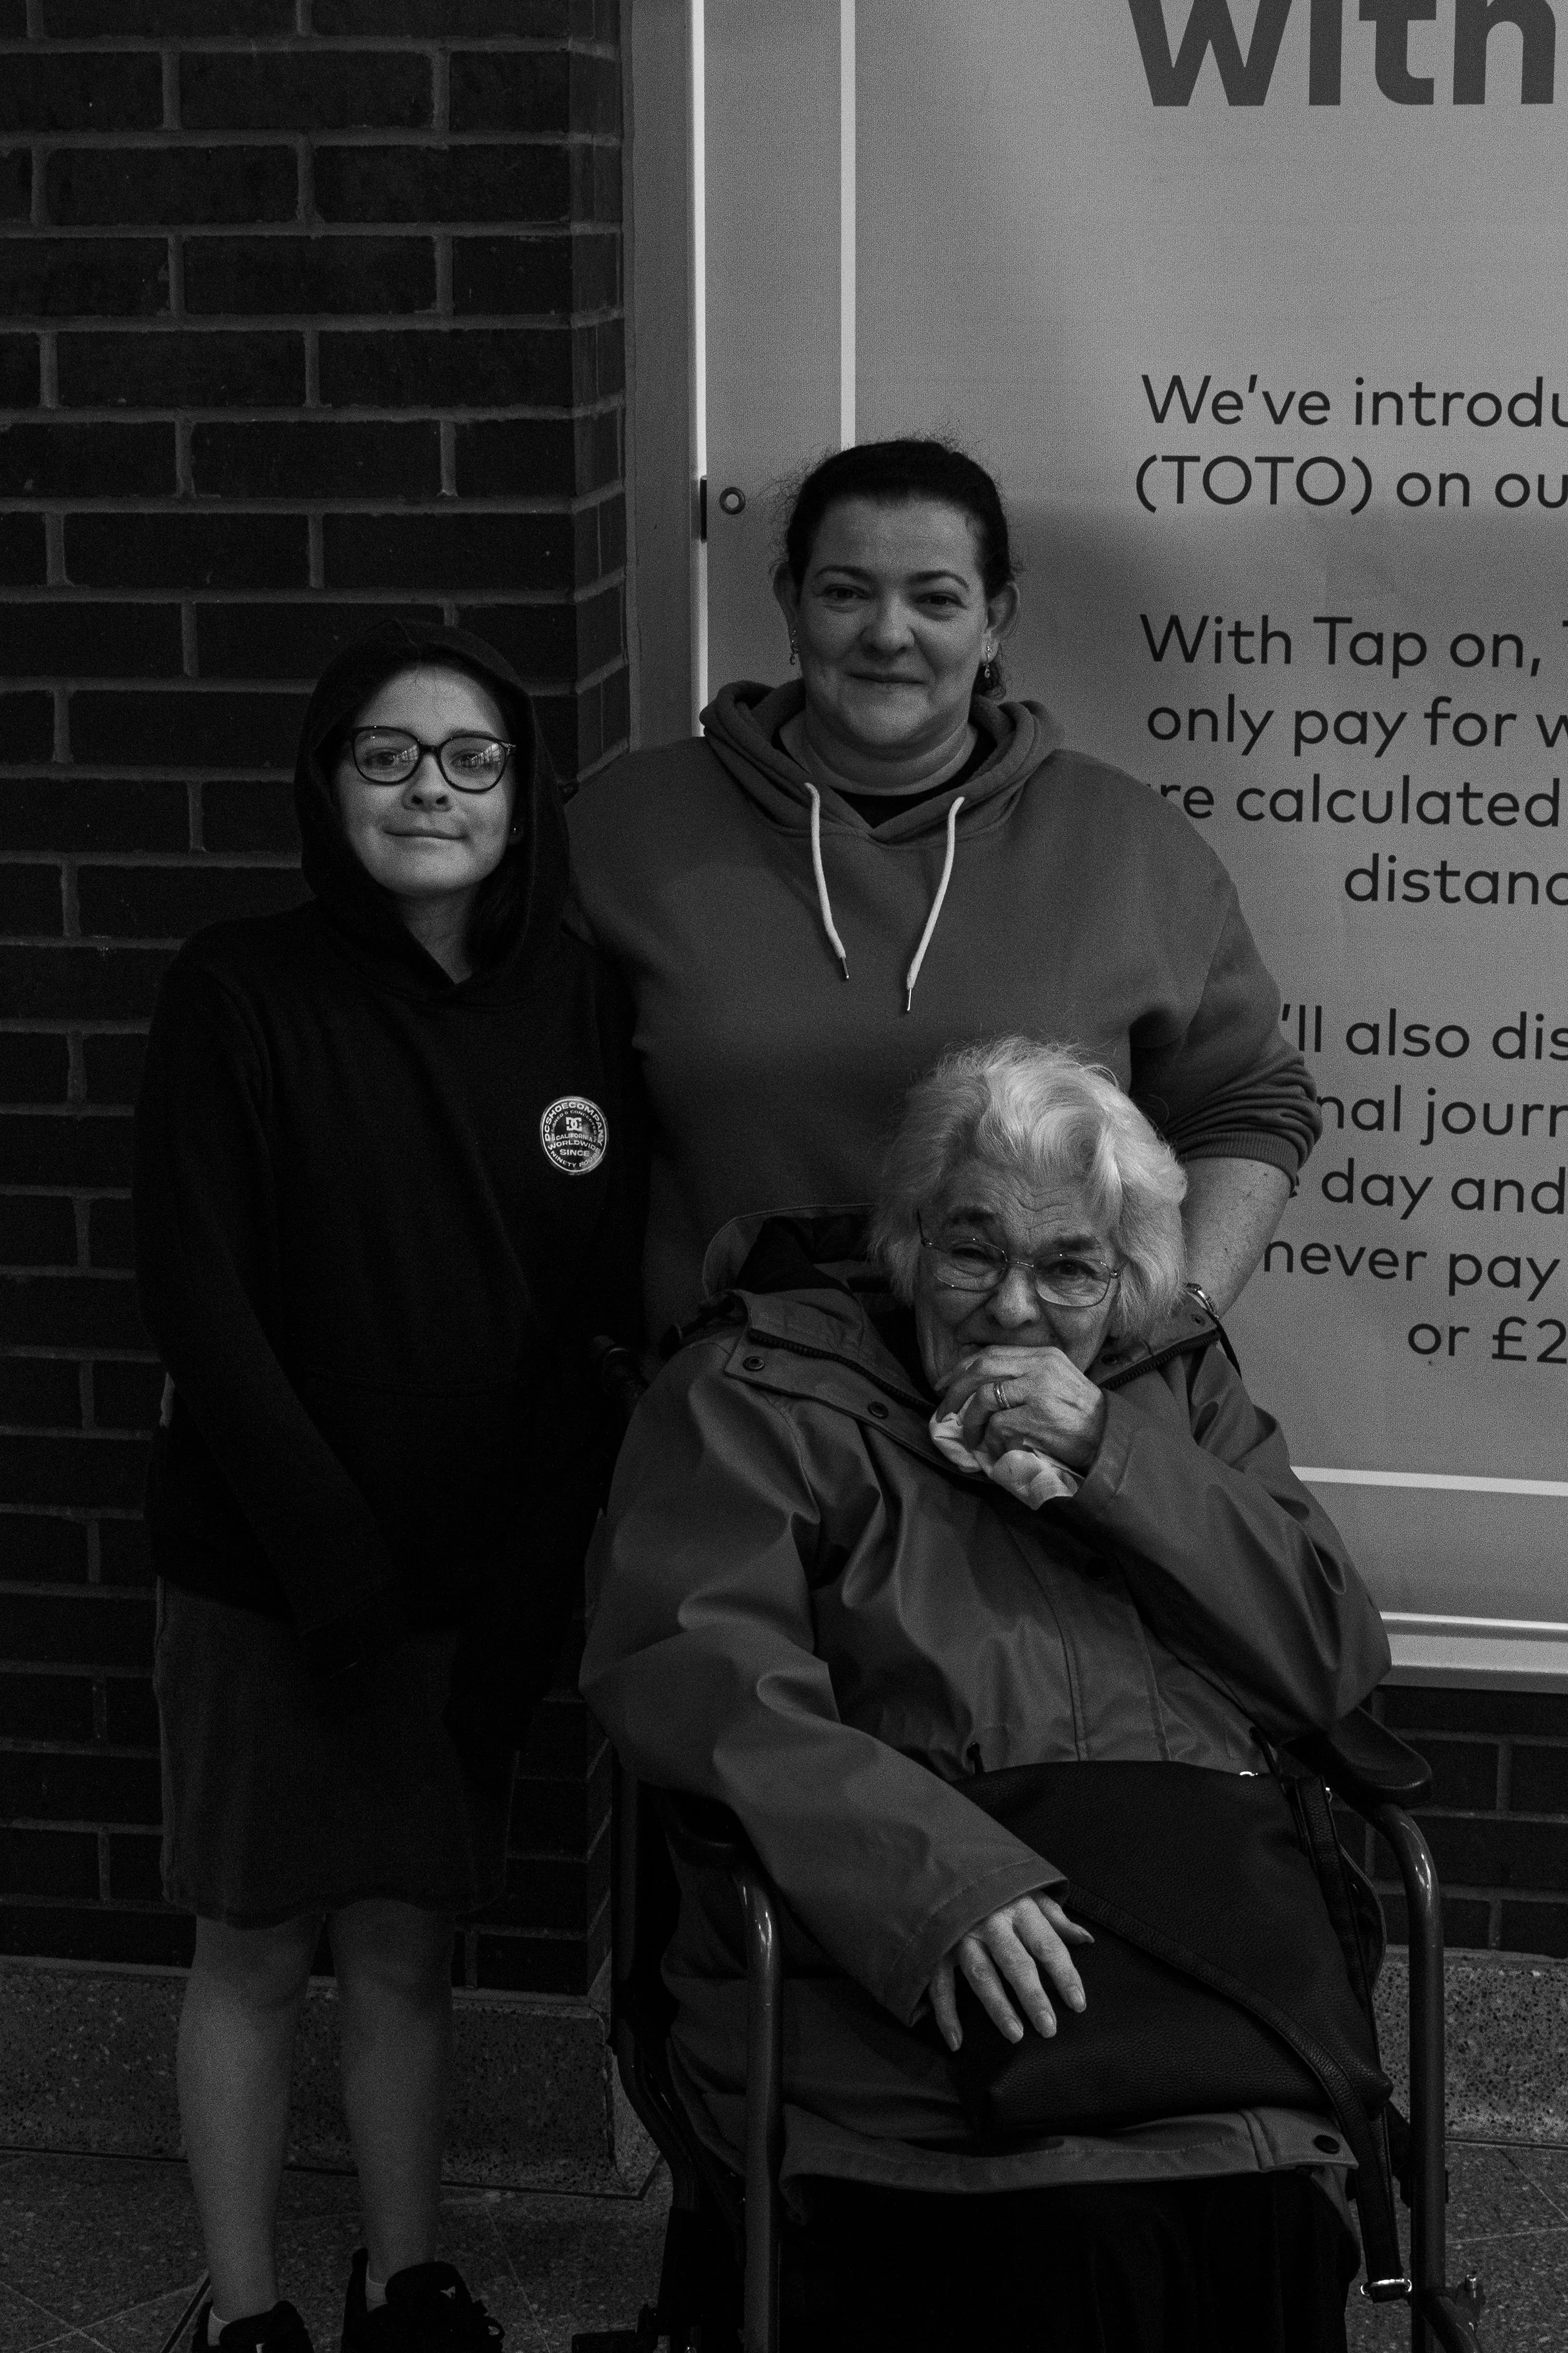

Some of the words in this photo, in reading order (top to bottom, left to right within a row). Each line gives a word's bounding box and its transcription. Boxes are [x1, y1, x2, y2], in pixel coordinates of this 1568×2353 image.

[1142, 375, 1330, 425] We've
[1136, 455, 1372, 515] (TOTO)
[1396, 472, 1470, 507] on
[1495, 473, 1568, 508] ou
[1140, 614, 1291, 664] With
[1313, 617, 1427, 679] Tap
[1450, 633, 1540, 677] on,
[1147, 694, 1274, 755] only
[1294, 710, 1408, 757] pay
[1424, 696, 1517, 746] for
[1236, 774, 1560, 827] calculated
[1346, 1009, 1469, 1058] also
[1321, 1158, 1433, 1220] day
[1451, 1166, 1566, 1215] and
[1264, 1240, 1427, 1281] never
[1449, 1253, 1560, 1302] pay
[1408, 1323, 1470, 1356] or
[1492, 1317, 1567, 1364] £2
